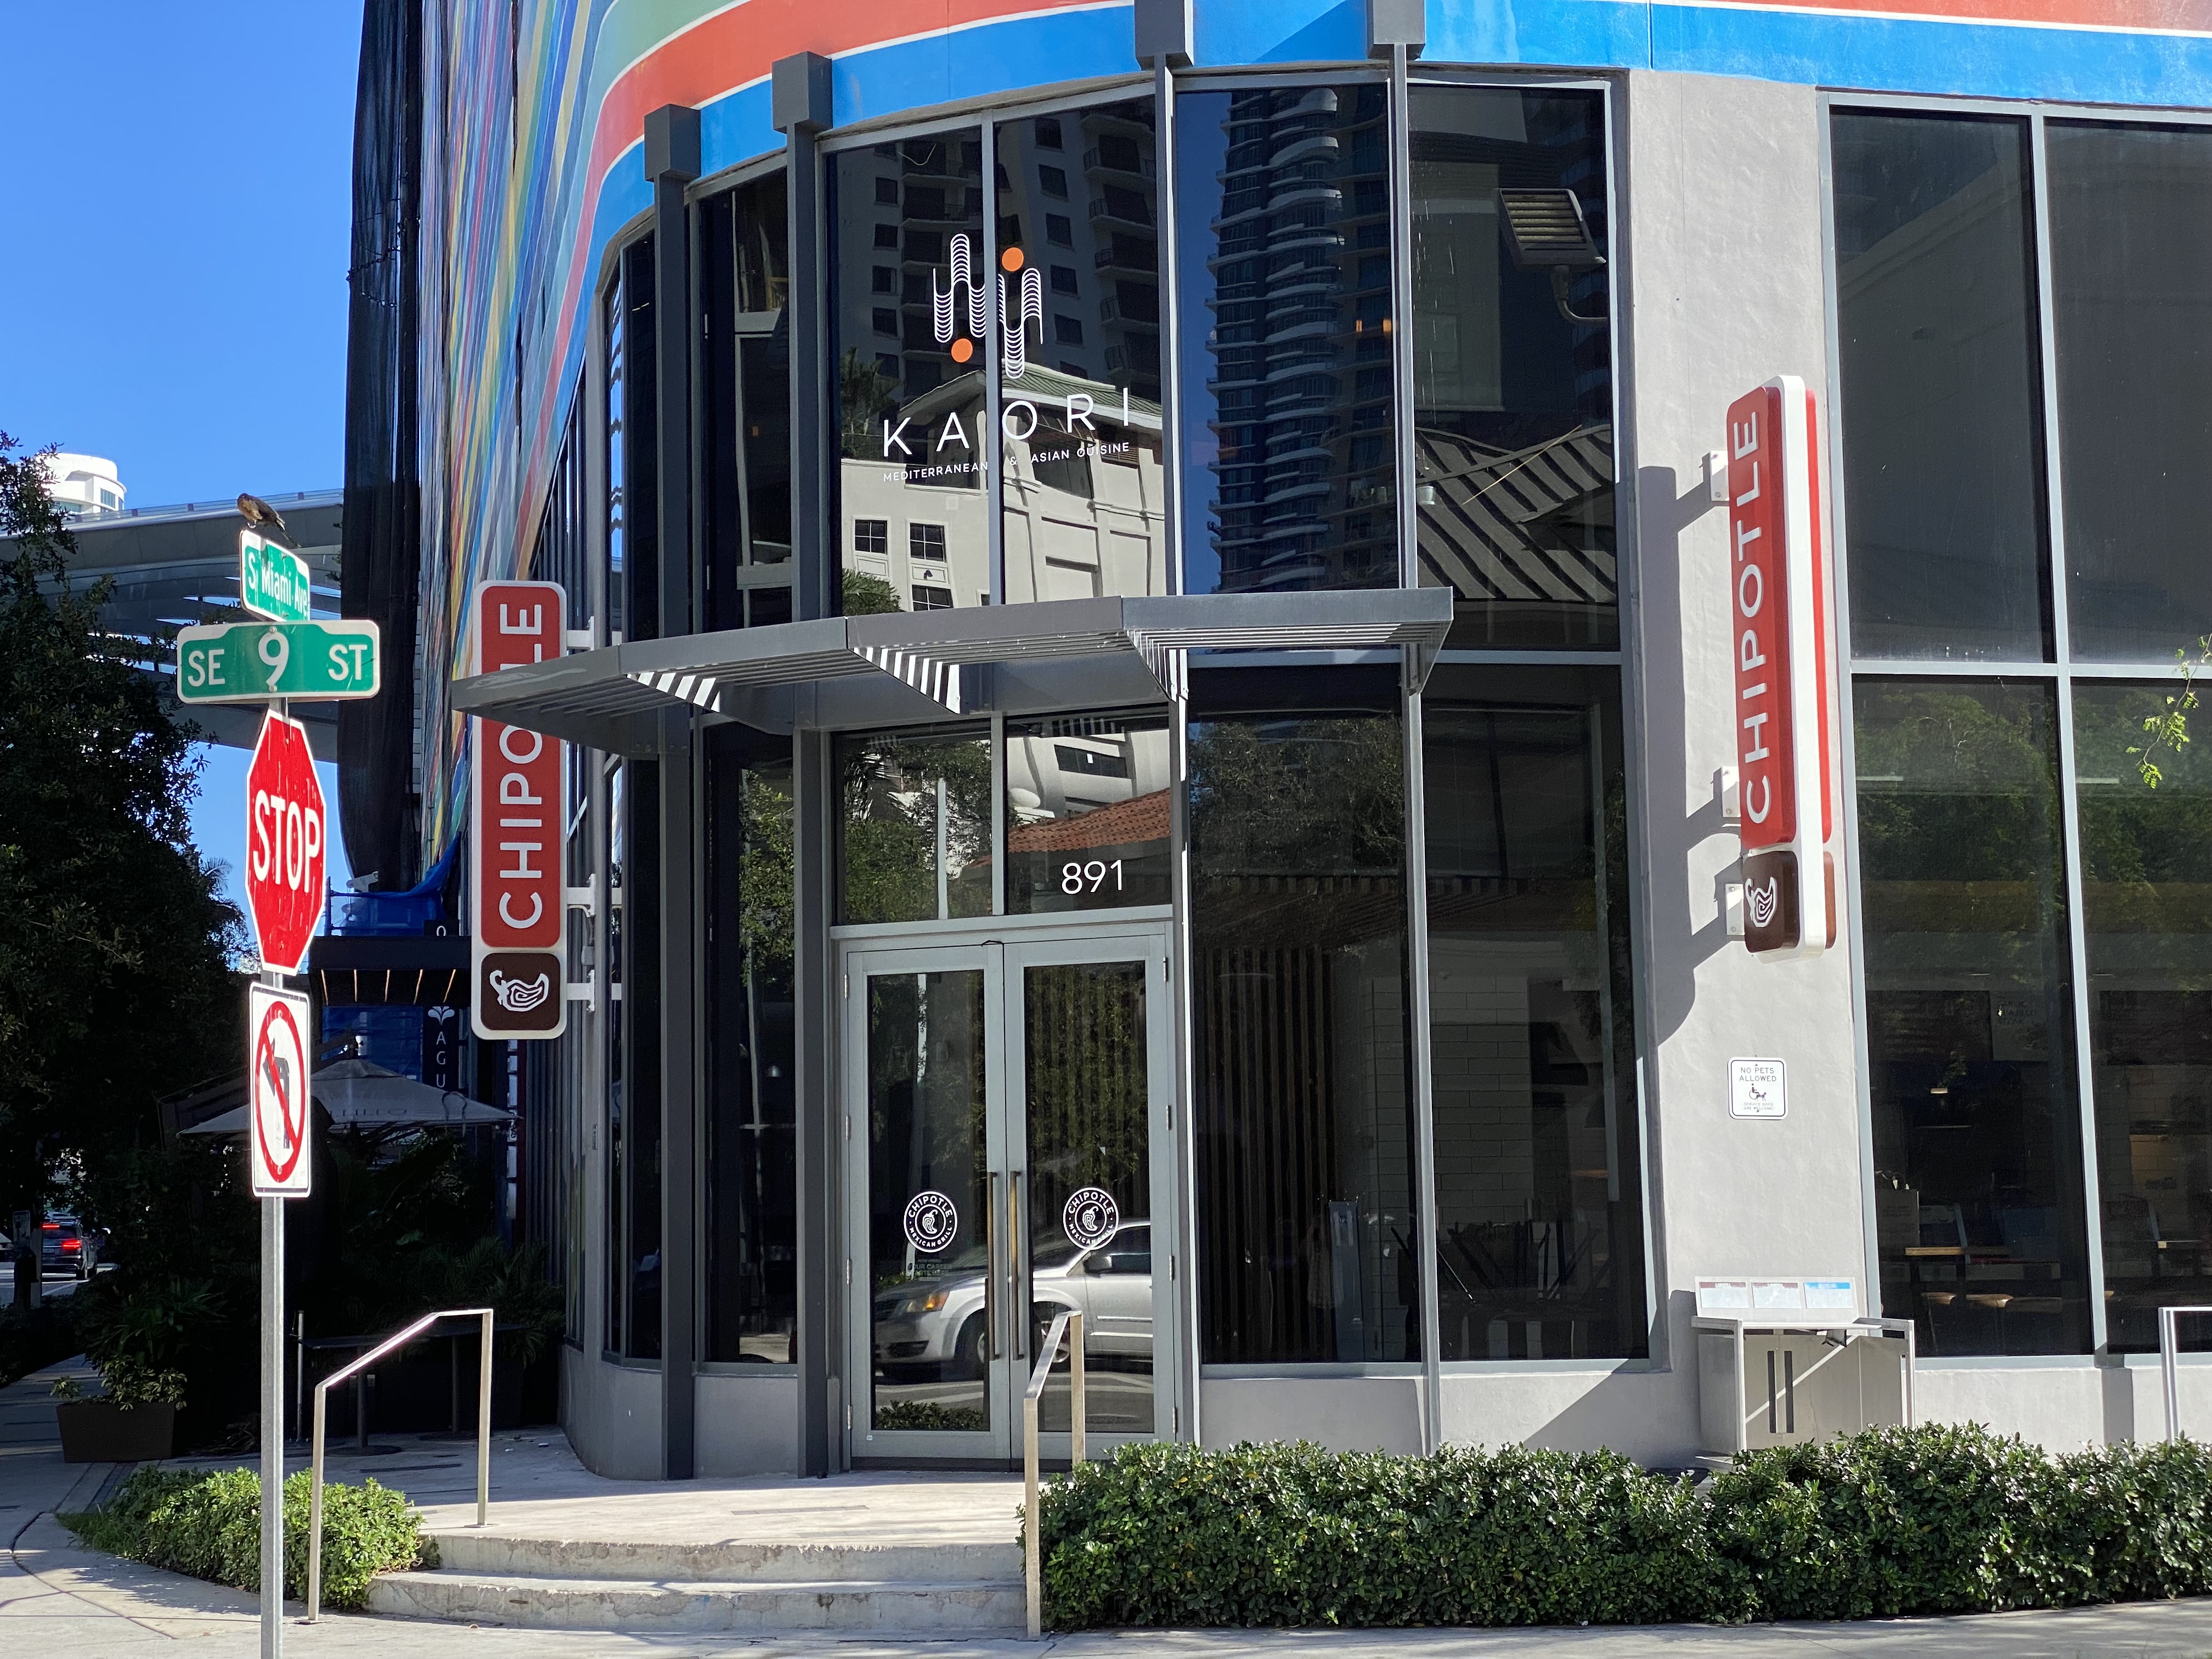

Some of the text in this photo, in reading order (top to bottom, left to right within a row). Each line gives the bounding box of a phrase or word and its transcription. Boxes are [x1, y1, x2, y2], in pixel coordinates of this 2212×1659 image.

[883, 387, 1128, 457] KAORI
[884, 442, 1130, 482] MEDITERRANEAN & ASIAN CUISINE
[248, 552, 308, 617] S Miami Ave
[1734, 411, 1771, 824] CHIPOTLE
[187, 632, 367, 687] SE 9 ST
[499, 603, 543, 929] CHIPOLE
[253, 789, 320, 893] STOP
[1062, 860, 1122, 894] 891
[909, 1196, 953, 1217] CHIPOTLE
[1068, 1192, 1114, 1215] CHIPOTLE
[910, 1227, 936, 1247] MEXICAN
[1069, 1224, 1096, 1245] MEXICAN
